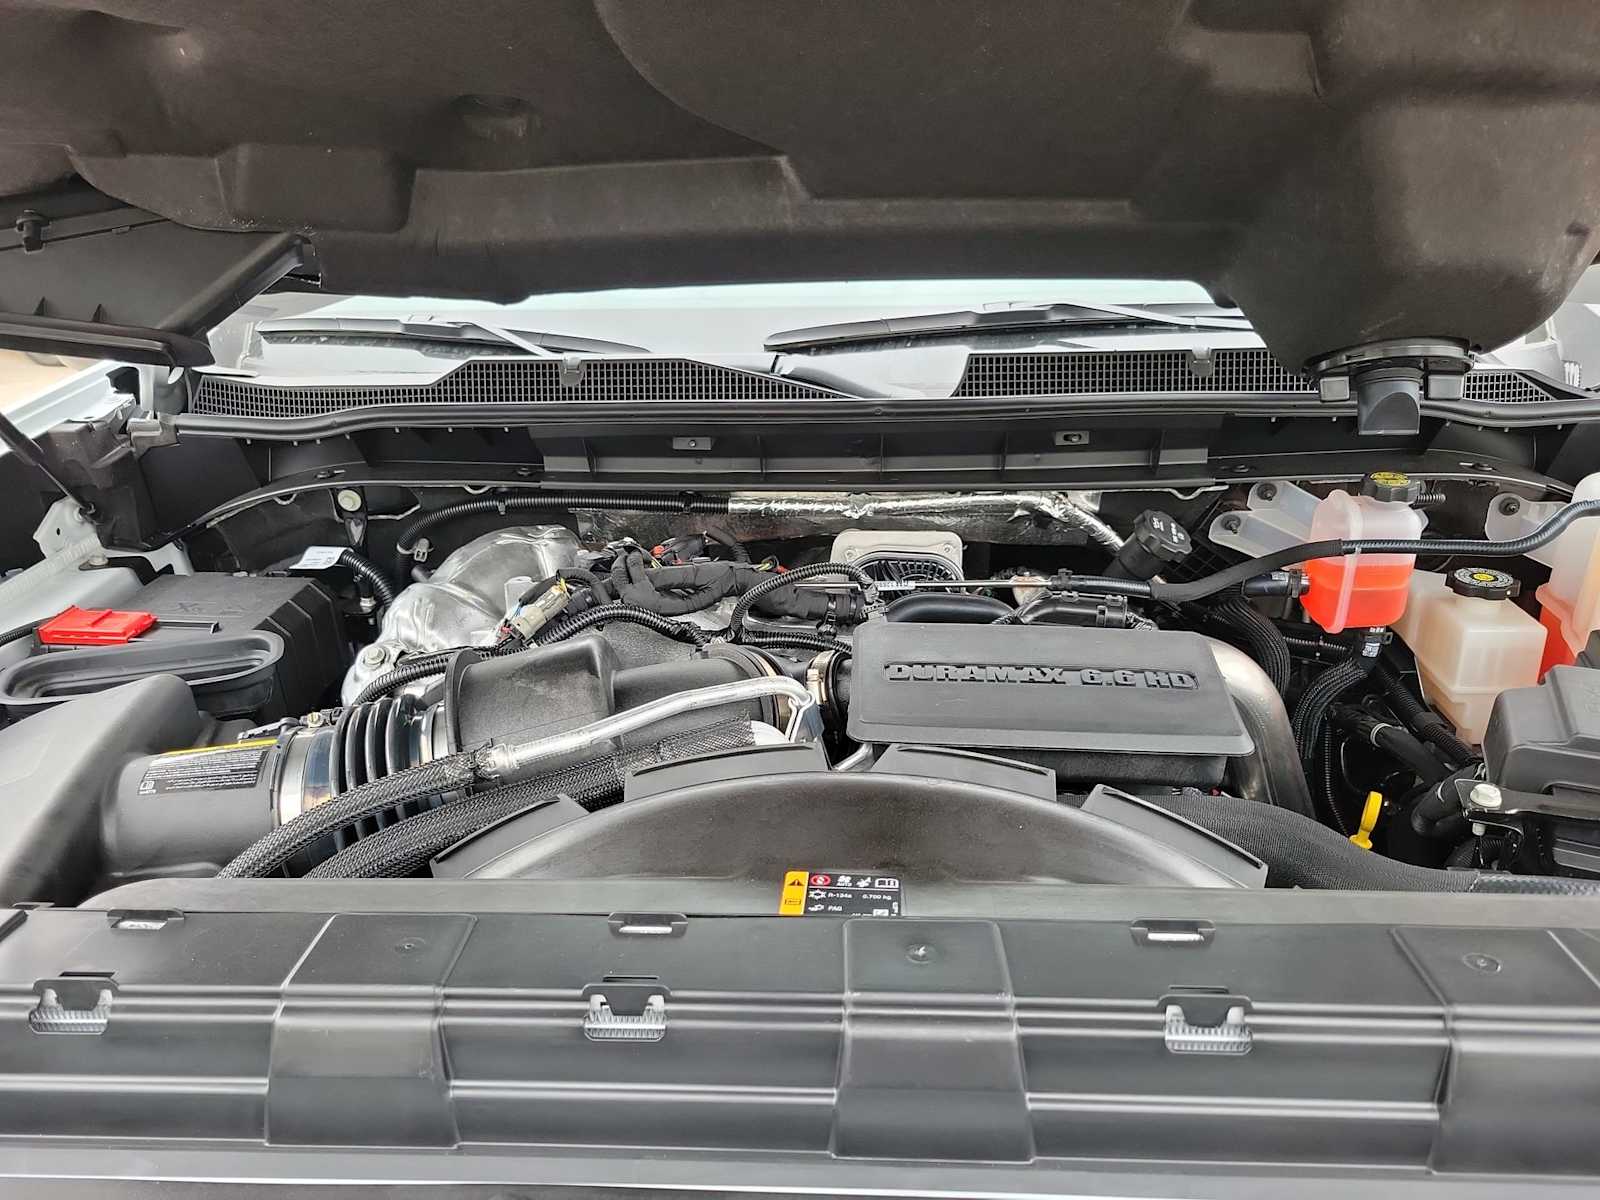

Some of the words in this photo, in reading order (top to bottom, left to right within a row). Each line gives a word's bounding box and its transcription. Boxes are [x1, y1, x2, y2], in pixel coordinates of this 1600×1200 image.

[887, 663, 1067, 684] DURAMAX
[1079, 668, 1137, 687] 6.6
[1144, 670, 1197, 690] HD
